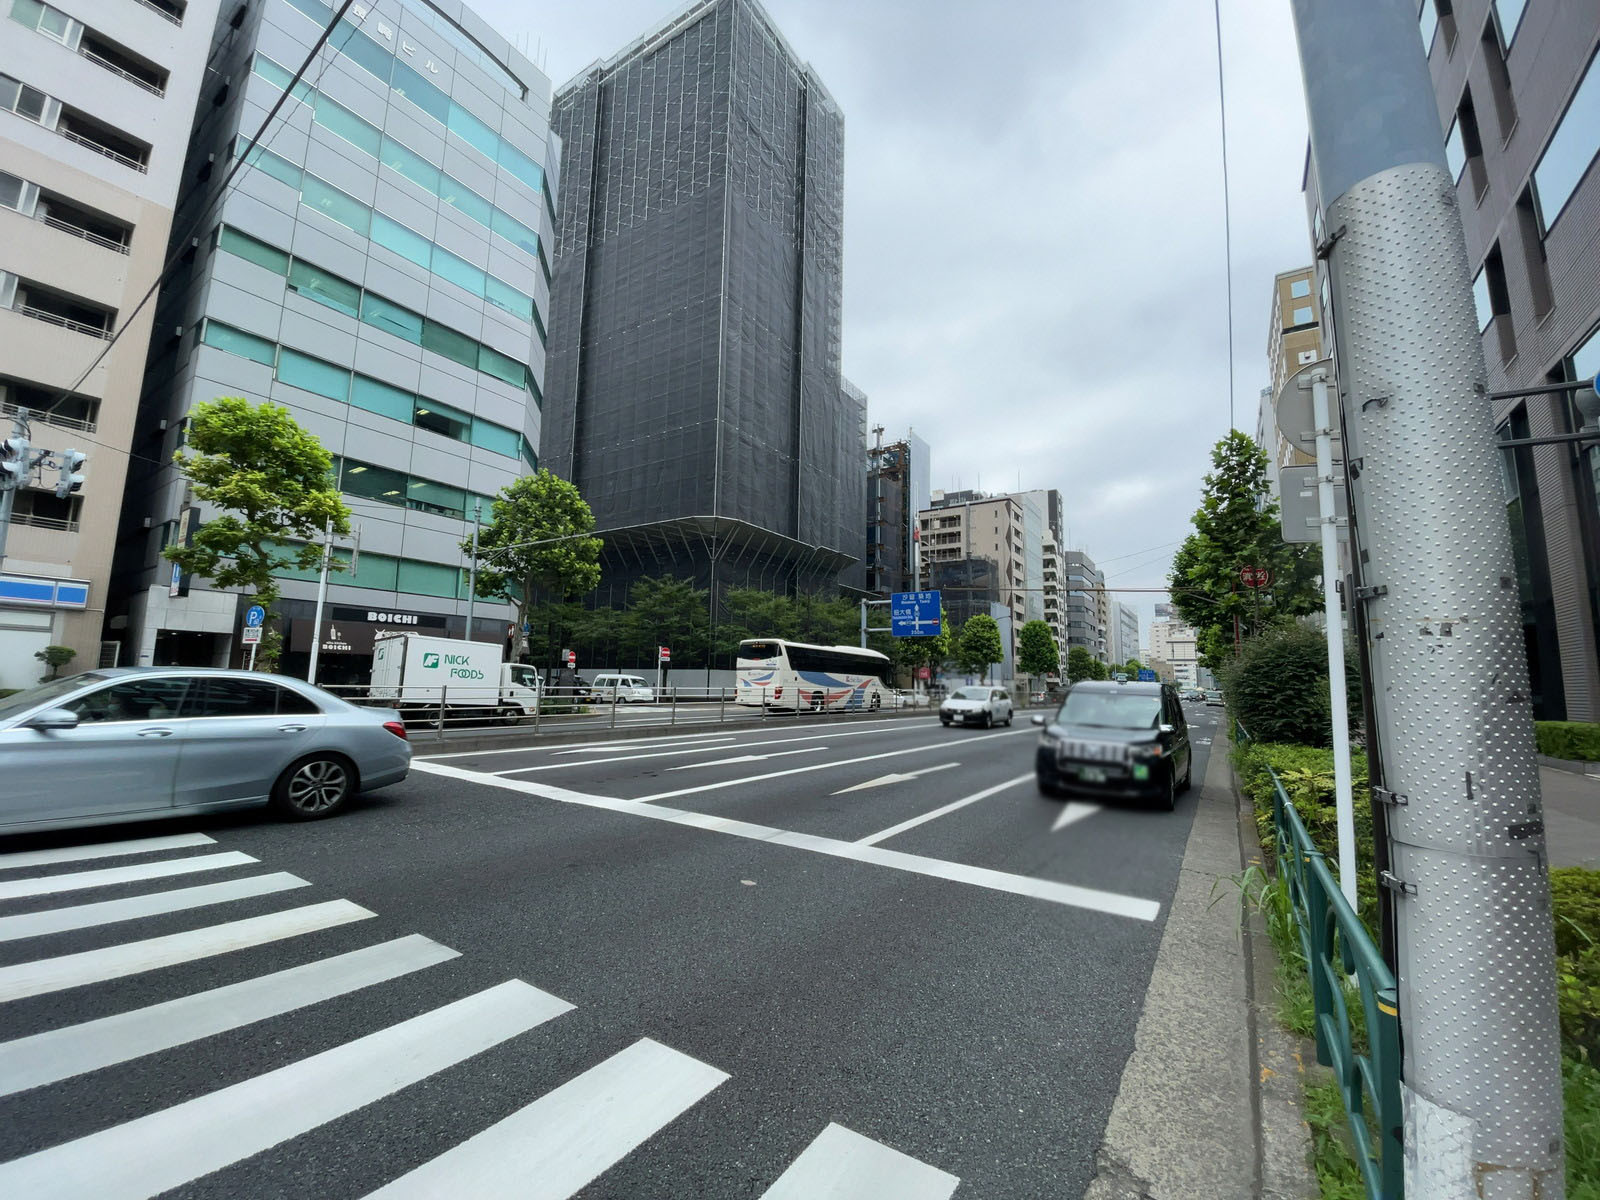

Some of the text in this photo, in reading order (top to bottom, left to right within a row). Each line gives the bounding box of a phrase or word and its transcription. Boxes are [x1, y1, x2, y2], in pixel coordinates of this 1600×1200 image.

[367, 611, 418, 625] BOICHI
[444, 654, 470, 666] NICK
[450, 668, 484, 680] FOODS
